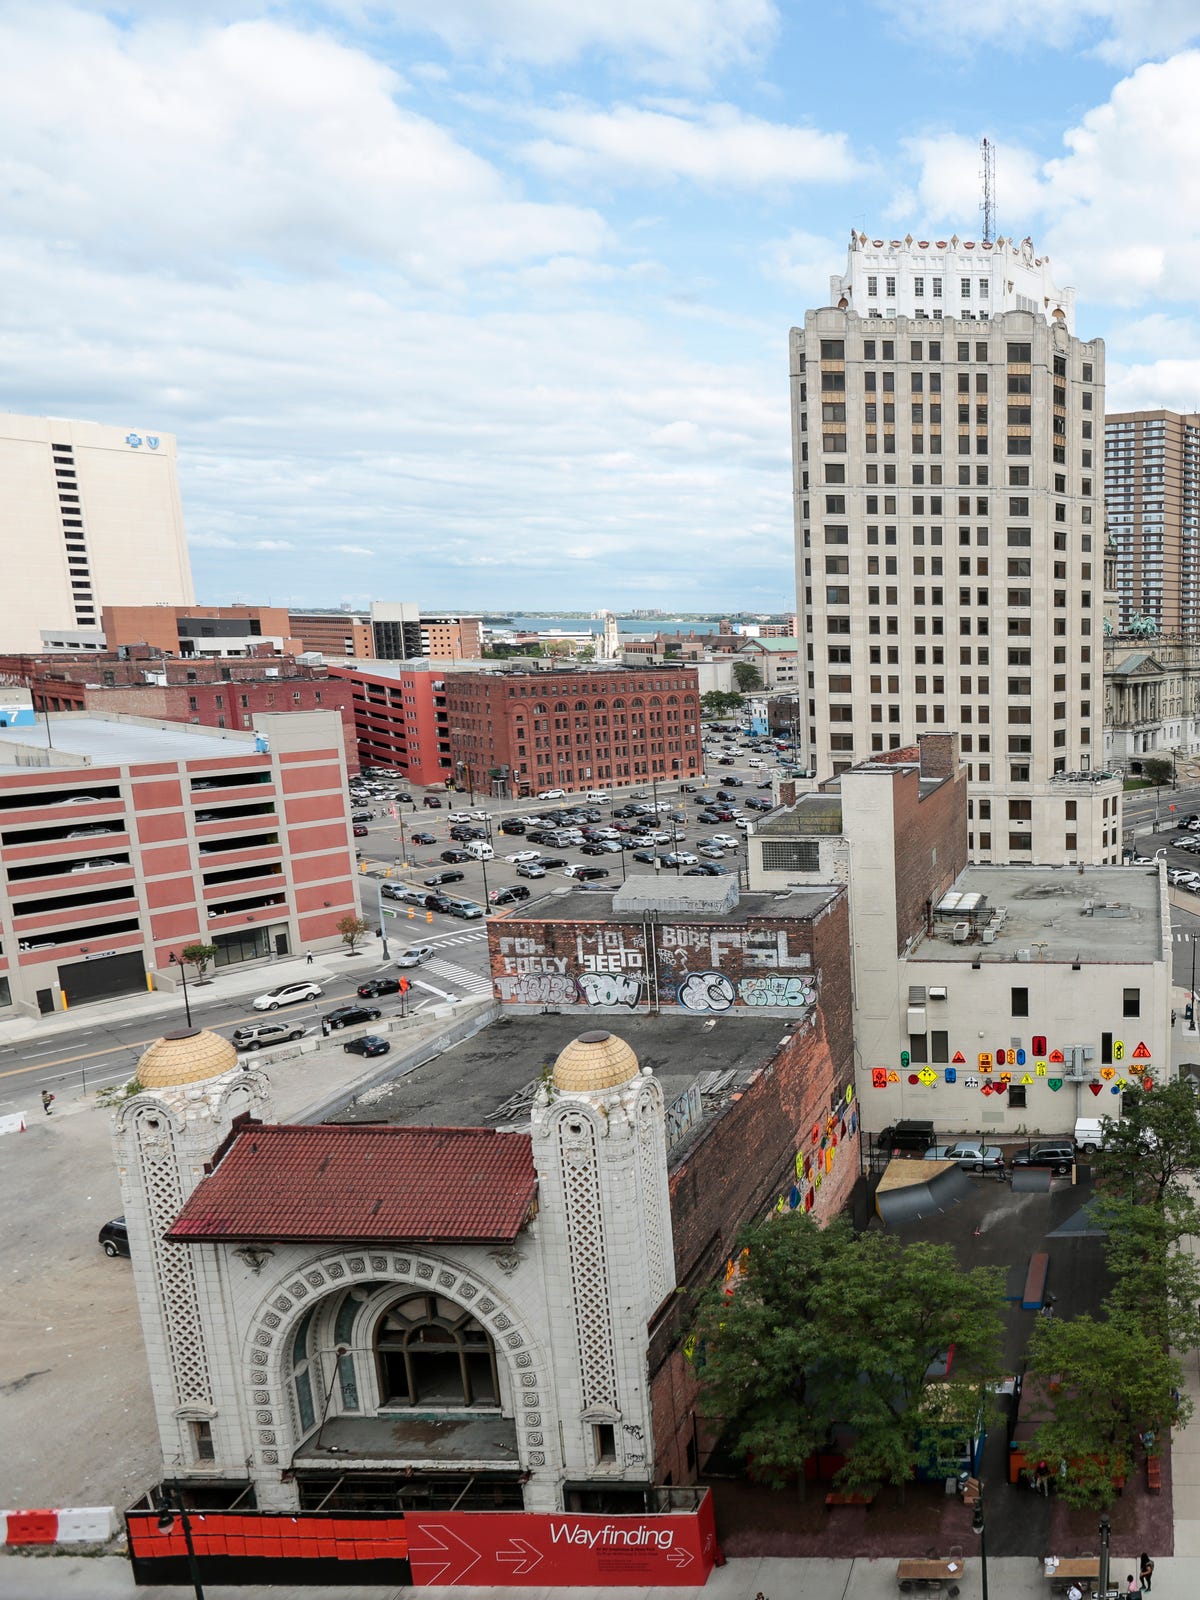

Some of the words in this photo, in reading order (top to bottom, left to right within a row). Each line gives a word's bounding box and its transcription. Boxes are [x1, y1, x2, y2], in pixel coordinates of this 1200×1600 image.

[7, 711, 19, 723] 7
[503, 956, 569, 974] FOGGY
[550, 1523, 674, 1550] Wayfinding
